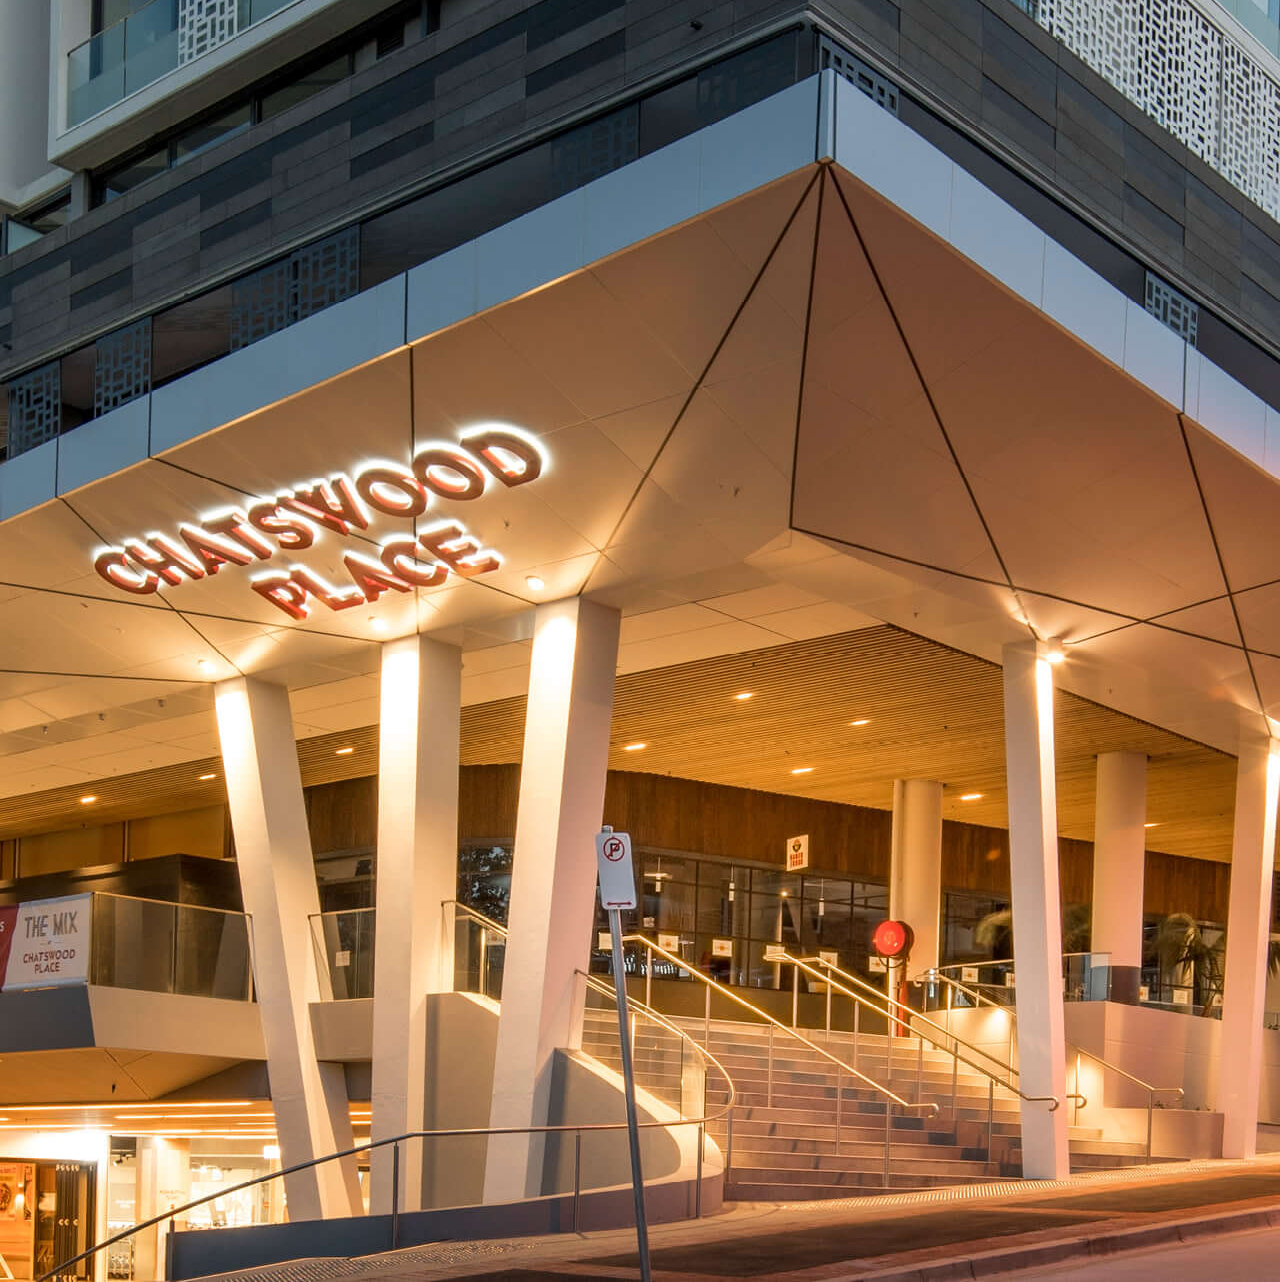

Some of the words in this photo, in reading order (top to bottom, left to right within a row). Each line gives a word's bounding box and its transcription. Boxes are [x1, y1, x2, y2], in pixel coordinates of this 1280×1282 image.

[93, 422, 549, 596] CHATSWOOD
[249, 519, 504, 621] PLACE
[25, 916, 48, 939] THE
[52, 911, 79, 936] MIX
[23, 949, 76, 964] CHATSWOOD
[34, 962, 61, 974] PLACE
